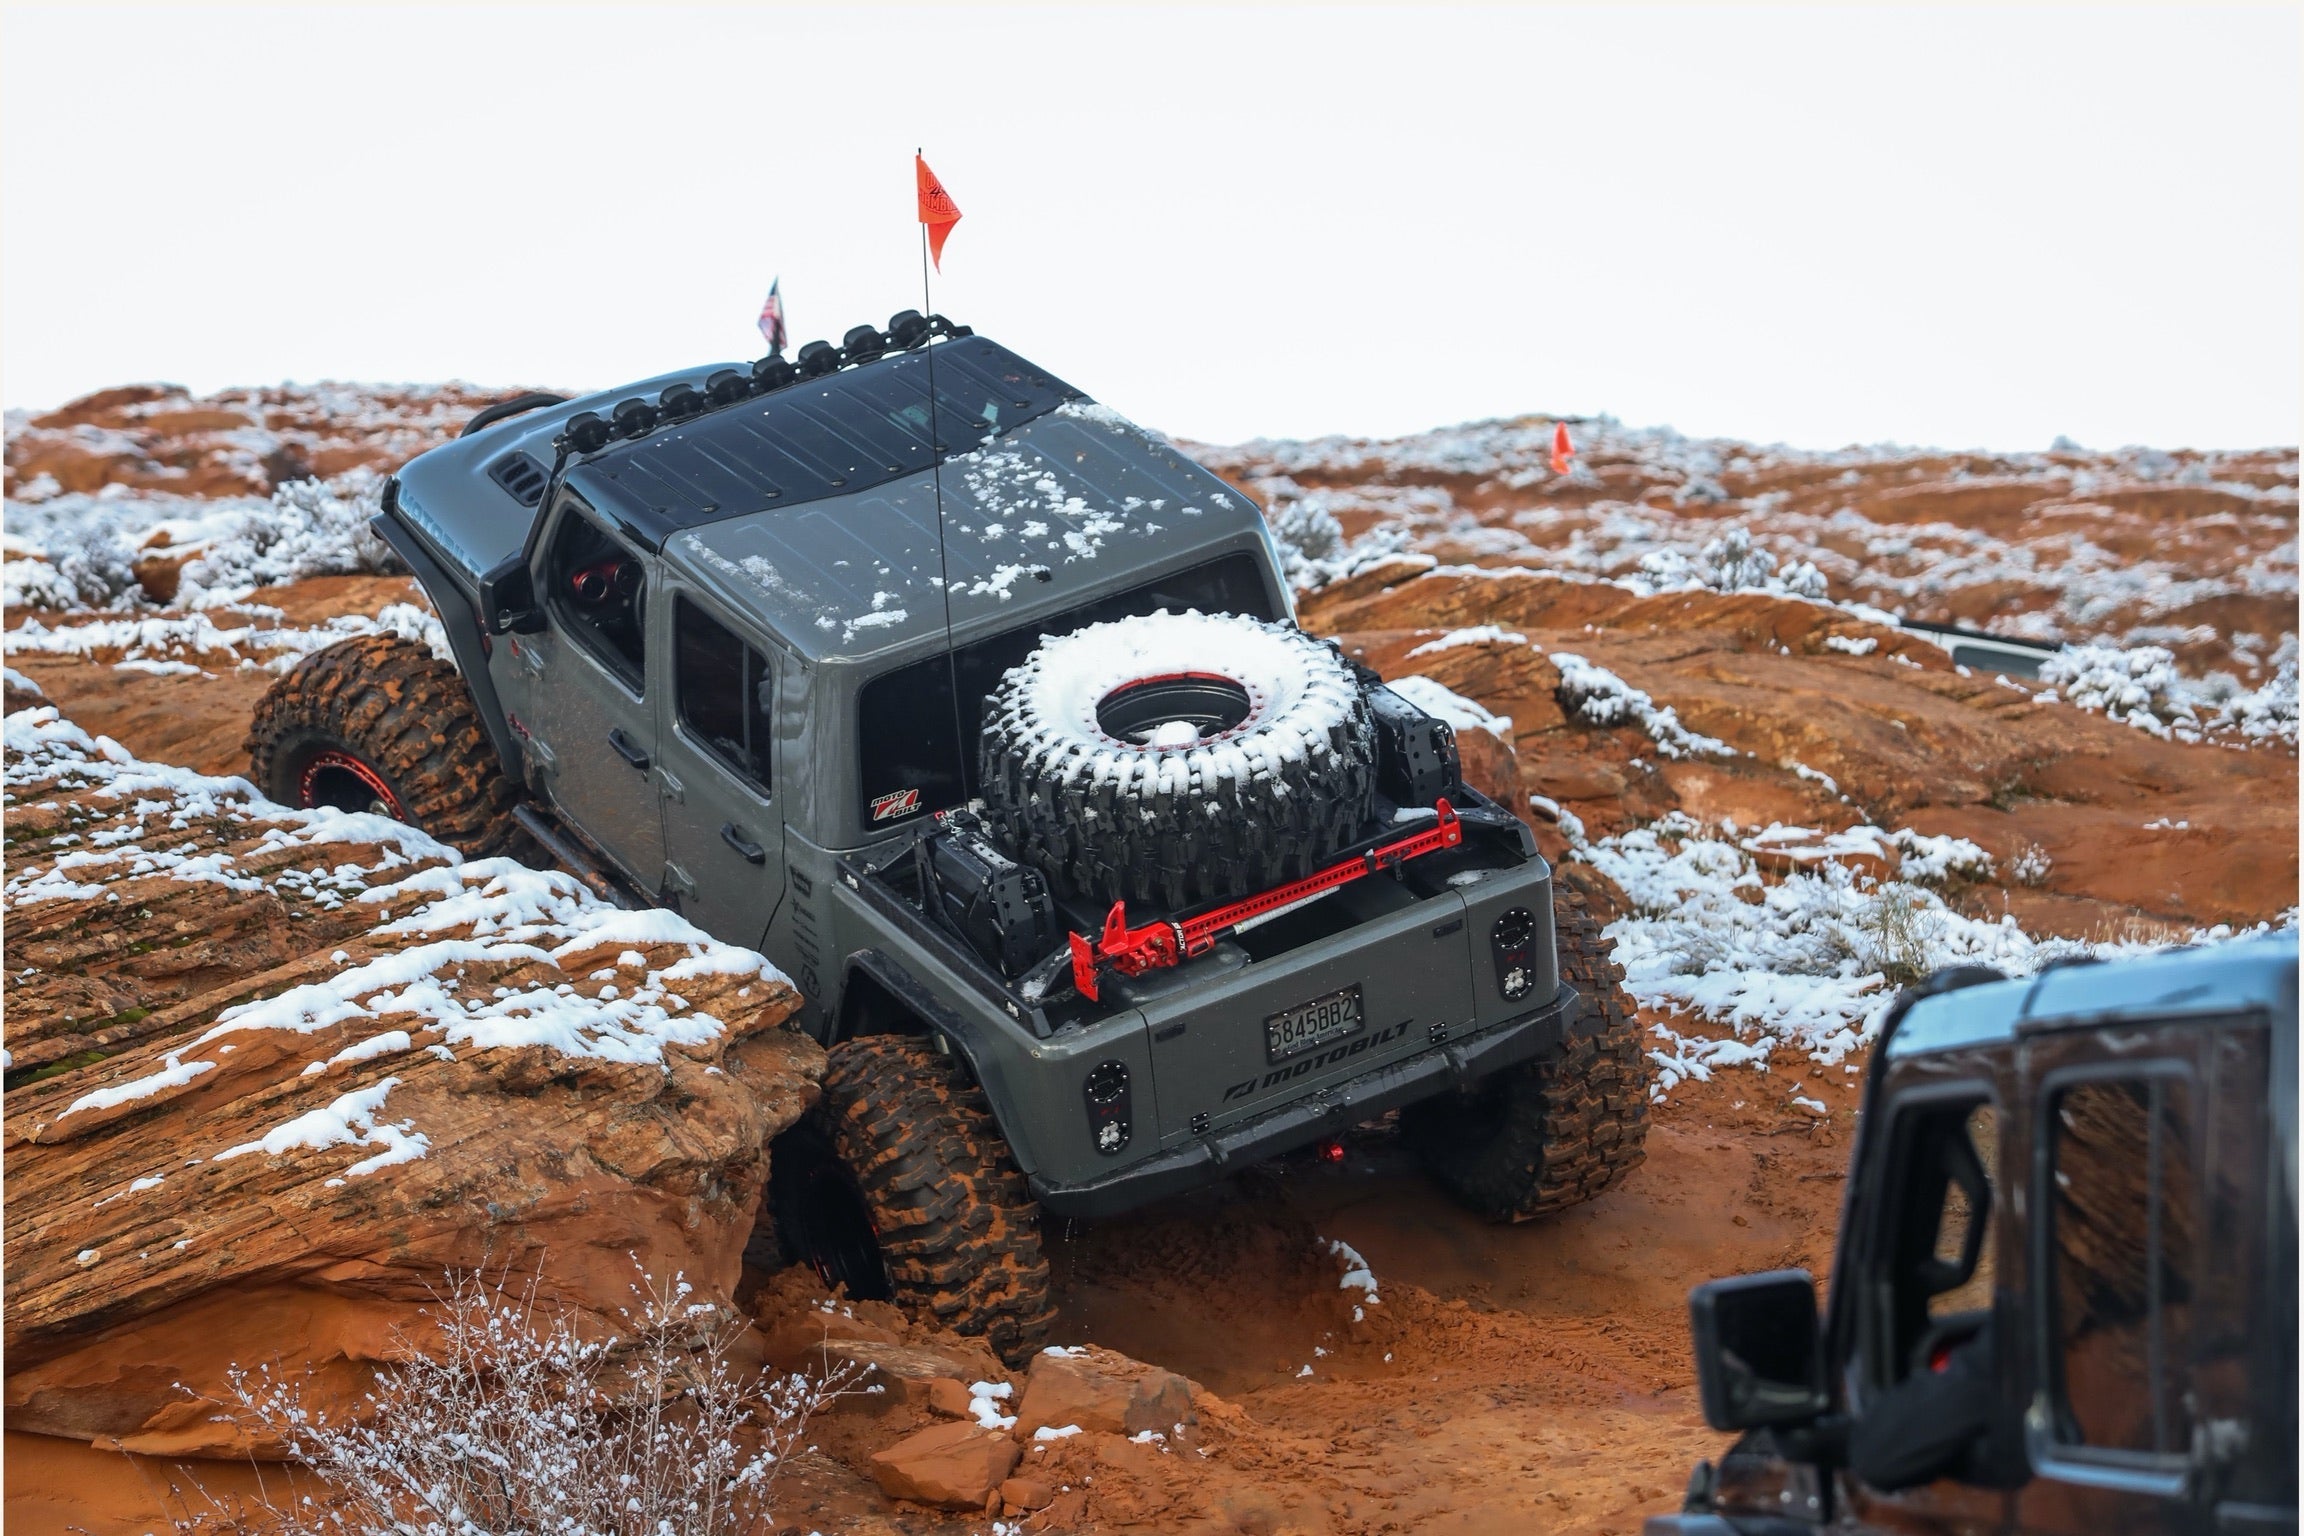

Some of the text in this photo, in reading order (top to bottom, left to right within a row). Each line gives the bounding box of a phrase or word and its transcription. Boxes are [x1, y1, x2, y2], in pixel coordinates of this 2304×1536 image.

[873, 791, 904, 805] MOTO
[895, 804, 919, 816] BILT
[1271, 997, 1354, 1048] 5845BB2
[1262, 1019, 1414, 1088] MOTOBILT
